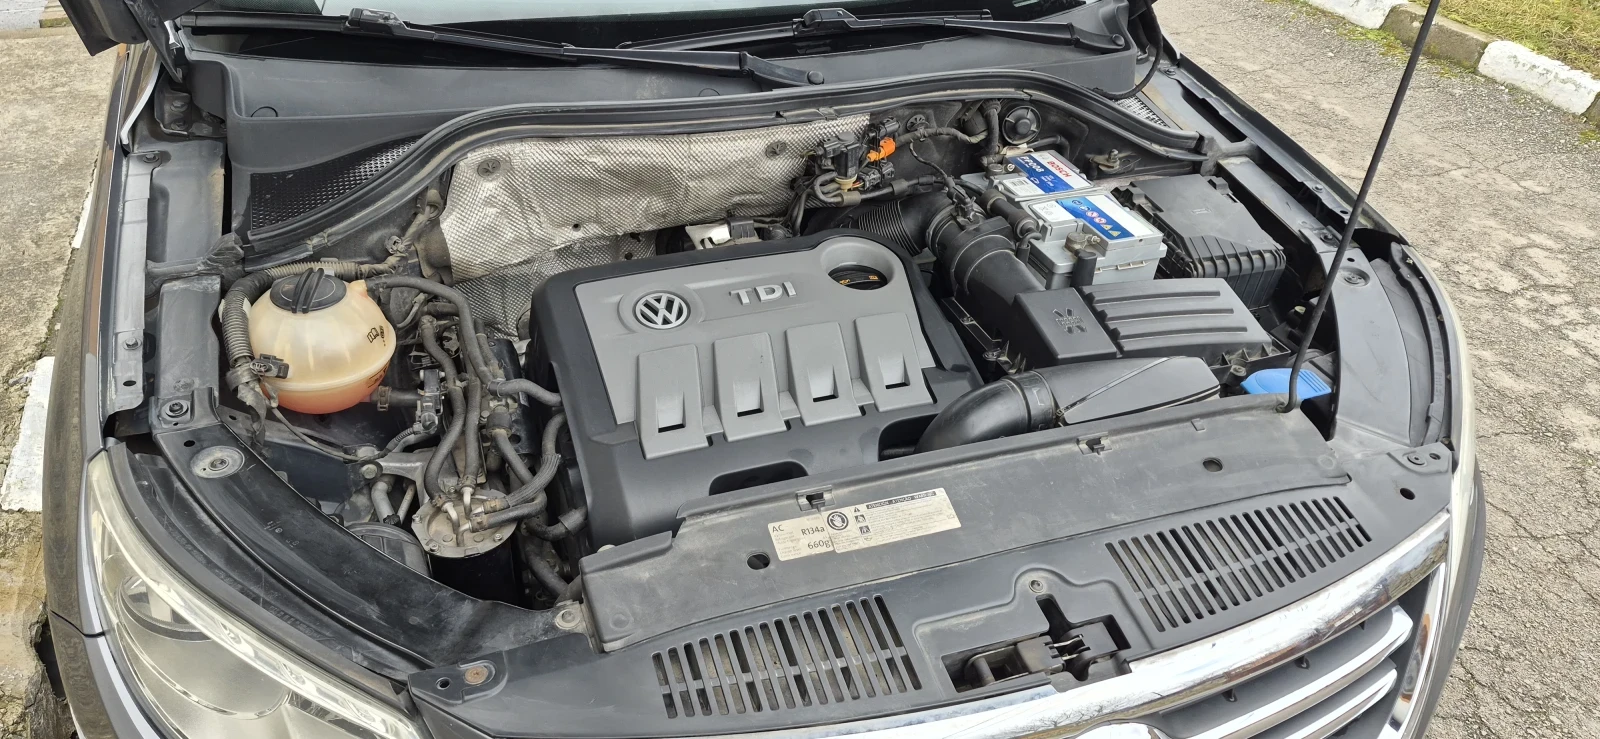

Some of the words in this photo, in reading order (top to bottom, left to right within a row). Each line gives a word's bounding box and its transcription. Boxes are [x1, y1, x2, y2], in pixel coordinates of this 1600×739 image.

[1047, 161, 1072, 177] BOSCH
[729, 281, 797, 305] TDI
[772, 524, 785, 533] AC
[801, 527, 826, 536] R134a
[807, 538, 831, 549] 660g
